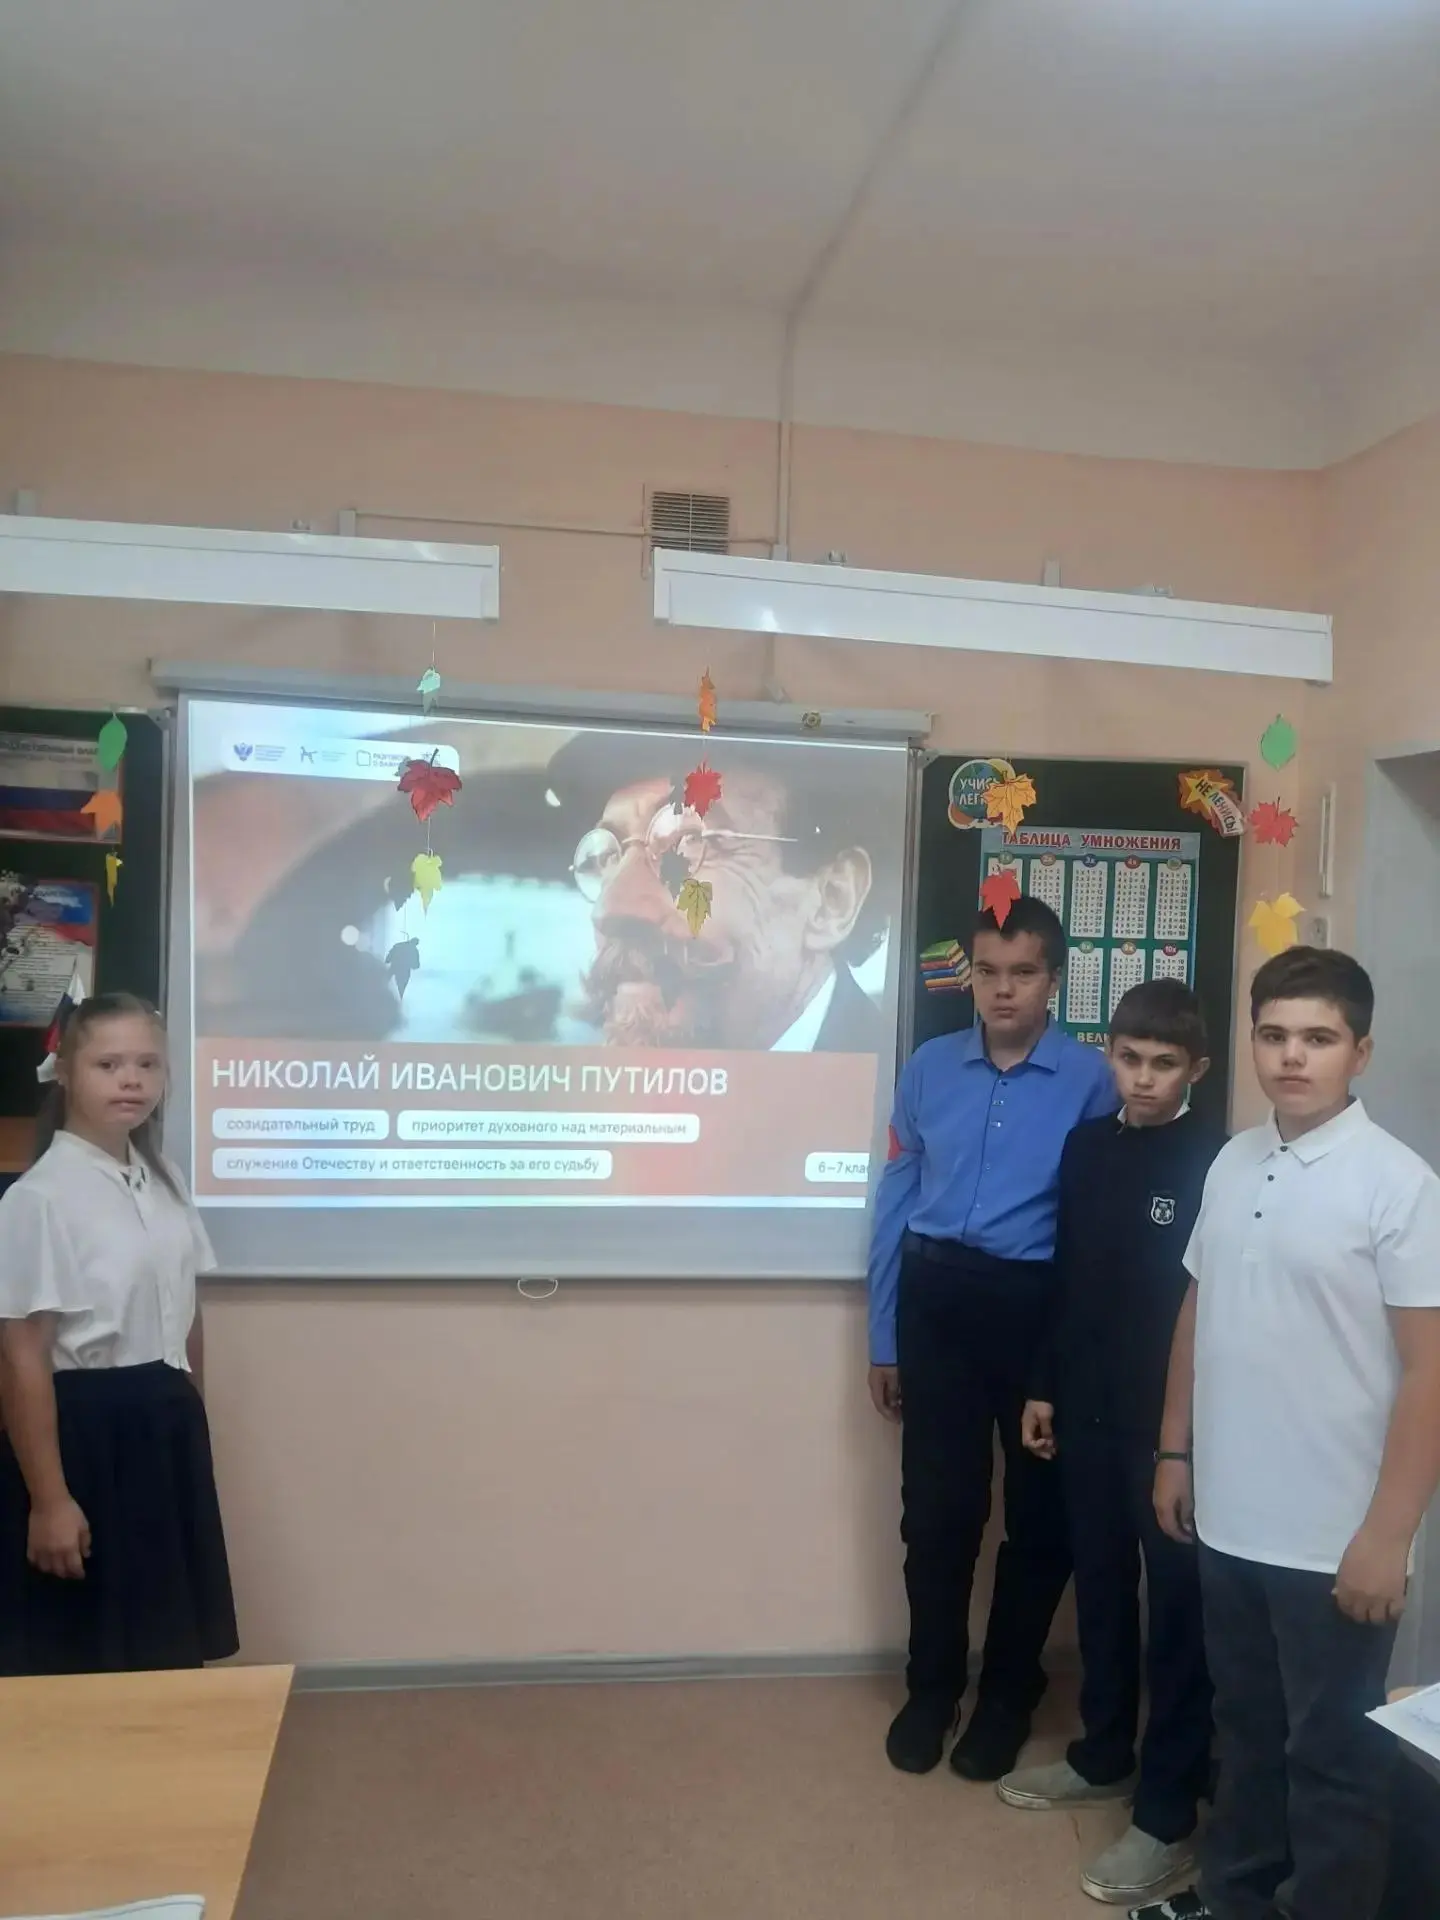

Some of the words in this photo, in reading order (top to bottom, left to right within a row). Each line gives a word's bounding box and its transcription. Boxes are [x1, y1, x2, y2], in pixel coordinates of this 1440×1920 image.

[1195, 779, 1213, 796] НЕ
[1002, 831, 1072, 848] ТАБЛИЦА
[1080, 834, 1181, 850] УМНОЖЕНИЯ
[212, 1053, 380, 1090] НИКОЛАЙ
[391, 1061, 571, 1092] ИВАНОВИЧ
[581, 1065, 728, 1096] ПУТИЛОВ
[227, 1117, 339, 1133] созидательный
[343, 1120, 376, 1135] труд
[412, 1120, 484, 1134] приоритет
[488, 1121, 558, 1135] духовного
[561, 1123, 586, 1136] над
[589, 1123, 687, 1137] материальным
[226, 1158, 299, 1173] служение
[302, 1156, 376, 1173] Отечеству
[379, 1160, 389, 1170] и
[392, 1160, 506, 1171] ответственность
[509, 1161, 526, 1171] за
[528, 1161, 551, 1171] его
[554, 1157, 600, 1174] судьбу
